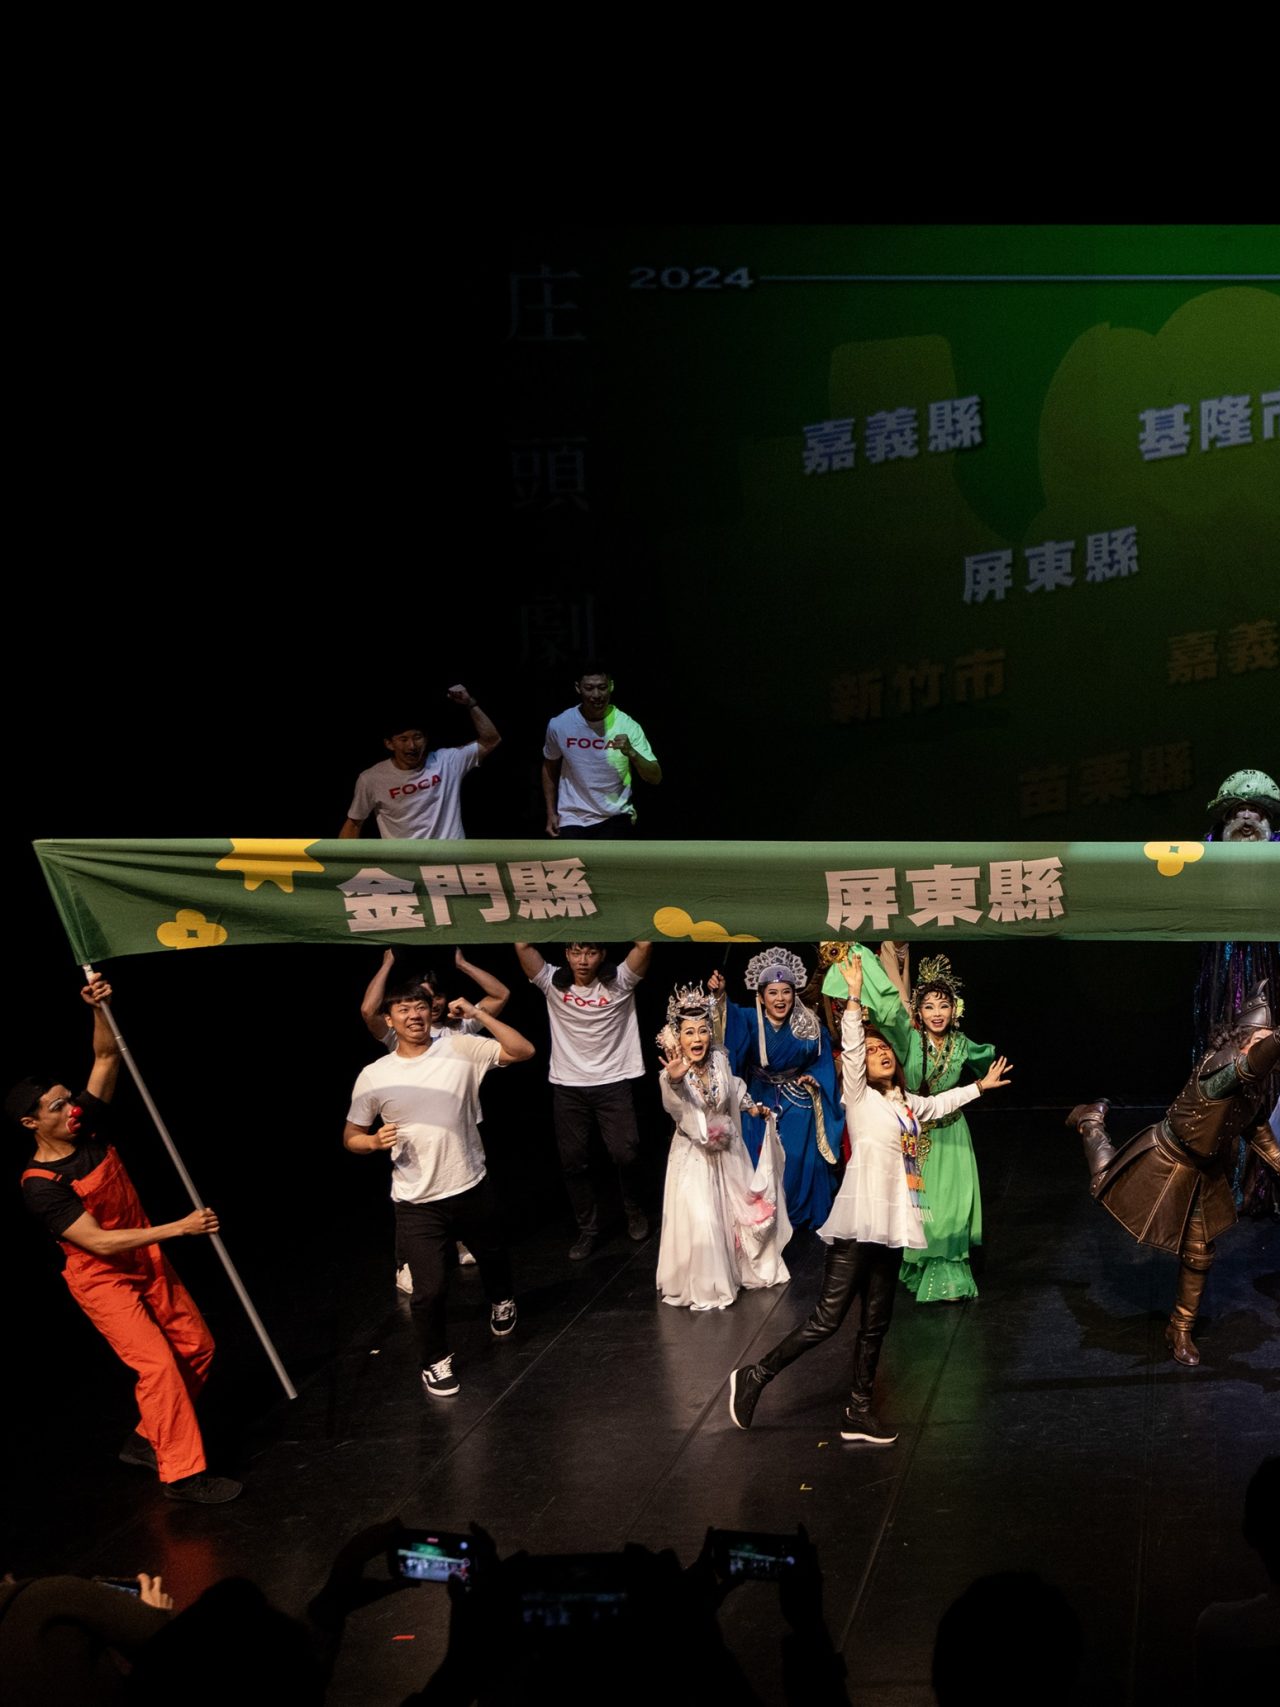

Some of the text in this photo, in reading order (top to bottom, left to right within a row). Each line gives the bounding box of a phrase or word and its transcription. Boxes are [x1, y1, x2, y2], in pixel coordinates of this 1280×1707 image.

[626, 264, 755, 291] 2024
[802, 393, 984, 476] 嘉義縣
[499, 262, 598, 826] 庄頭劇
[961, 524, 1140, 605] 屏東縣
[829, 646, 1008, 726] 新竹市
[565, 737, 616, 750] FOCA
[1017, 738, 1196, 820] 苗栗縣
[389, 774, 442, 799] FOCA
[336, 856, 599, 934] 金門縣
[823, 855, 1069, 932] 屏東縣
[562, 992, 610, 1008] FOCA
